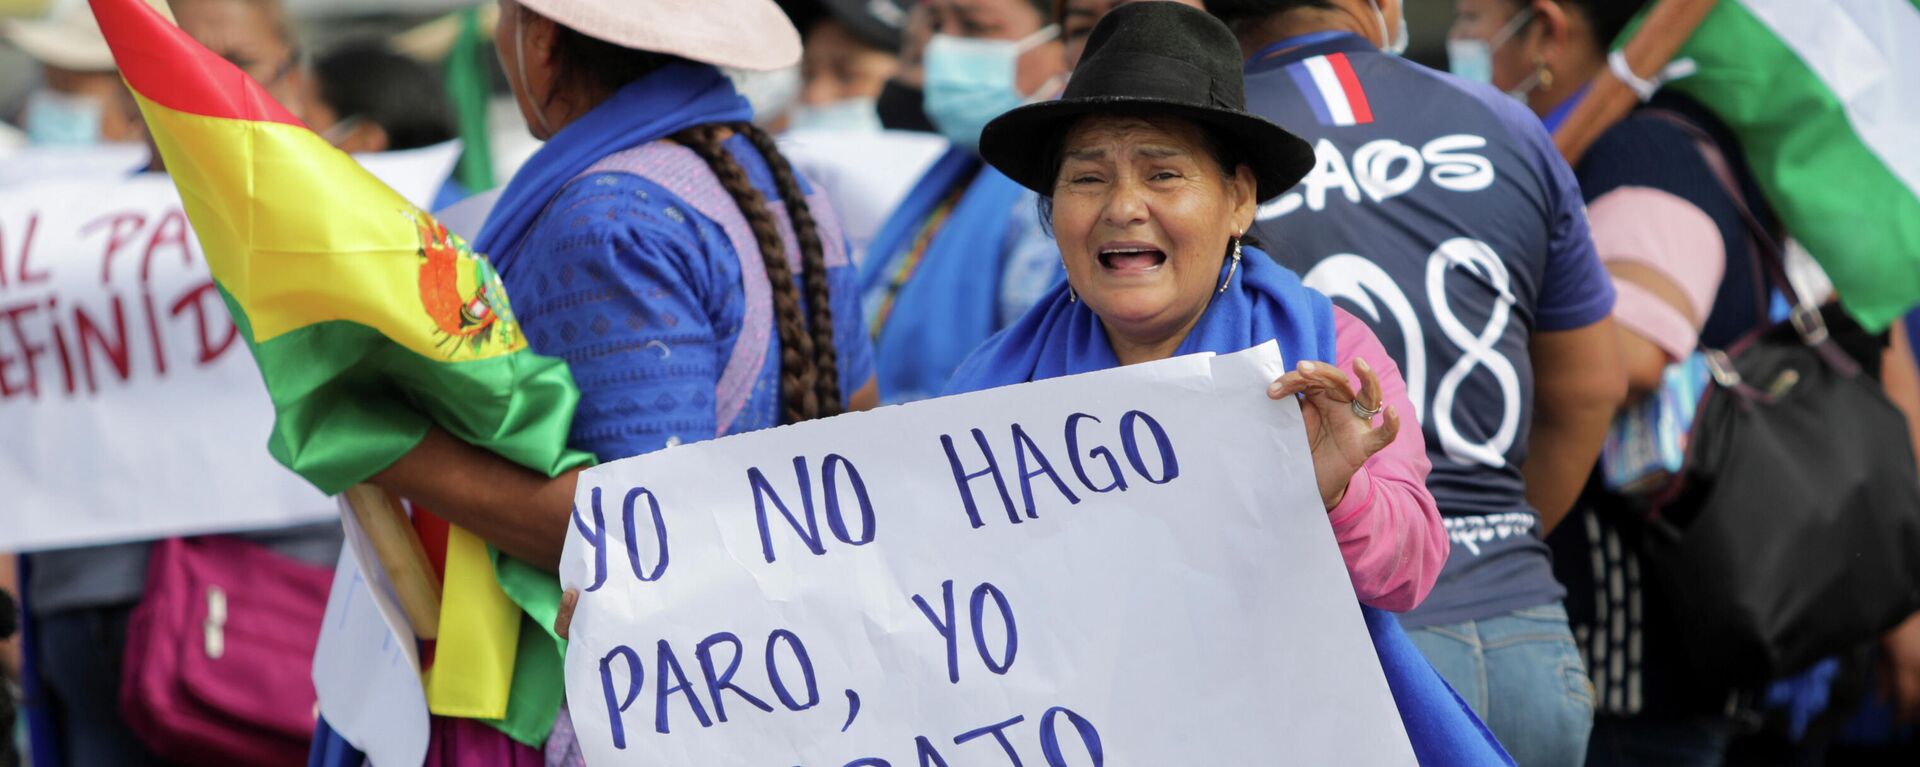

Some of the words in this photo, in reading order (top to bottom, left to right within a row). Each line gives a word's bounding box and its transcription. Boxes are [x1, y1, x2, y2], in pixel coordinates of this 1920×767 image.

[572, 485, 670, 593] YO
[746, 453, 876, 564] NO
[940, 409, 1180, 530] HAGO
[599, 628, 862, 750] PARO,
[911, 578, 1019, 684] YO
